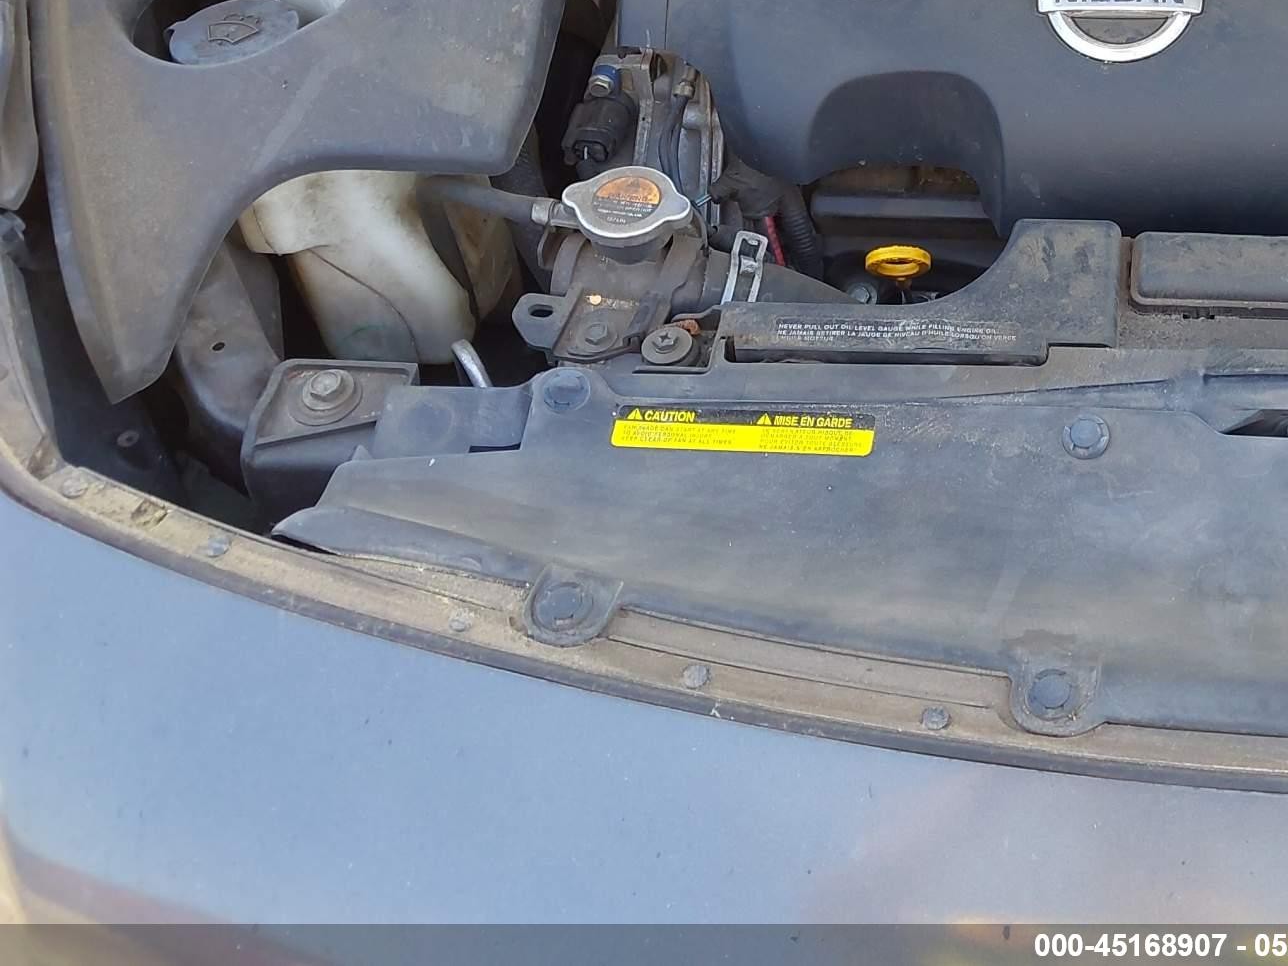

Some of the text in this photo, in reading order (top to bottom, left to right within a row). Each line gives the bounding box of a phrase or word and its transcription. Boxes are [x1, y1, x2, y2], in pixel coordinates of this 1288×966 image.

[644, 410, 695, 422] CAUTION
[773, 415, 854, 428] MISE EN GARDE
